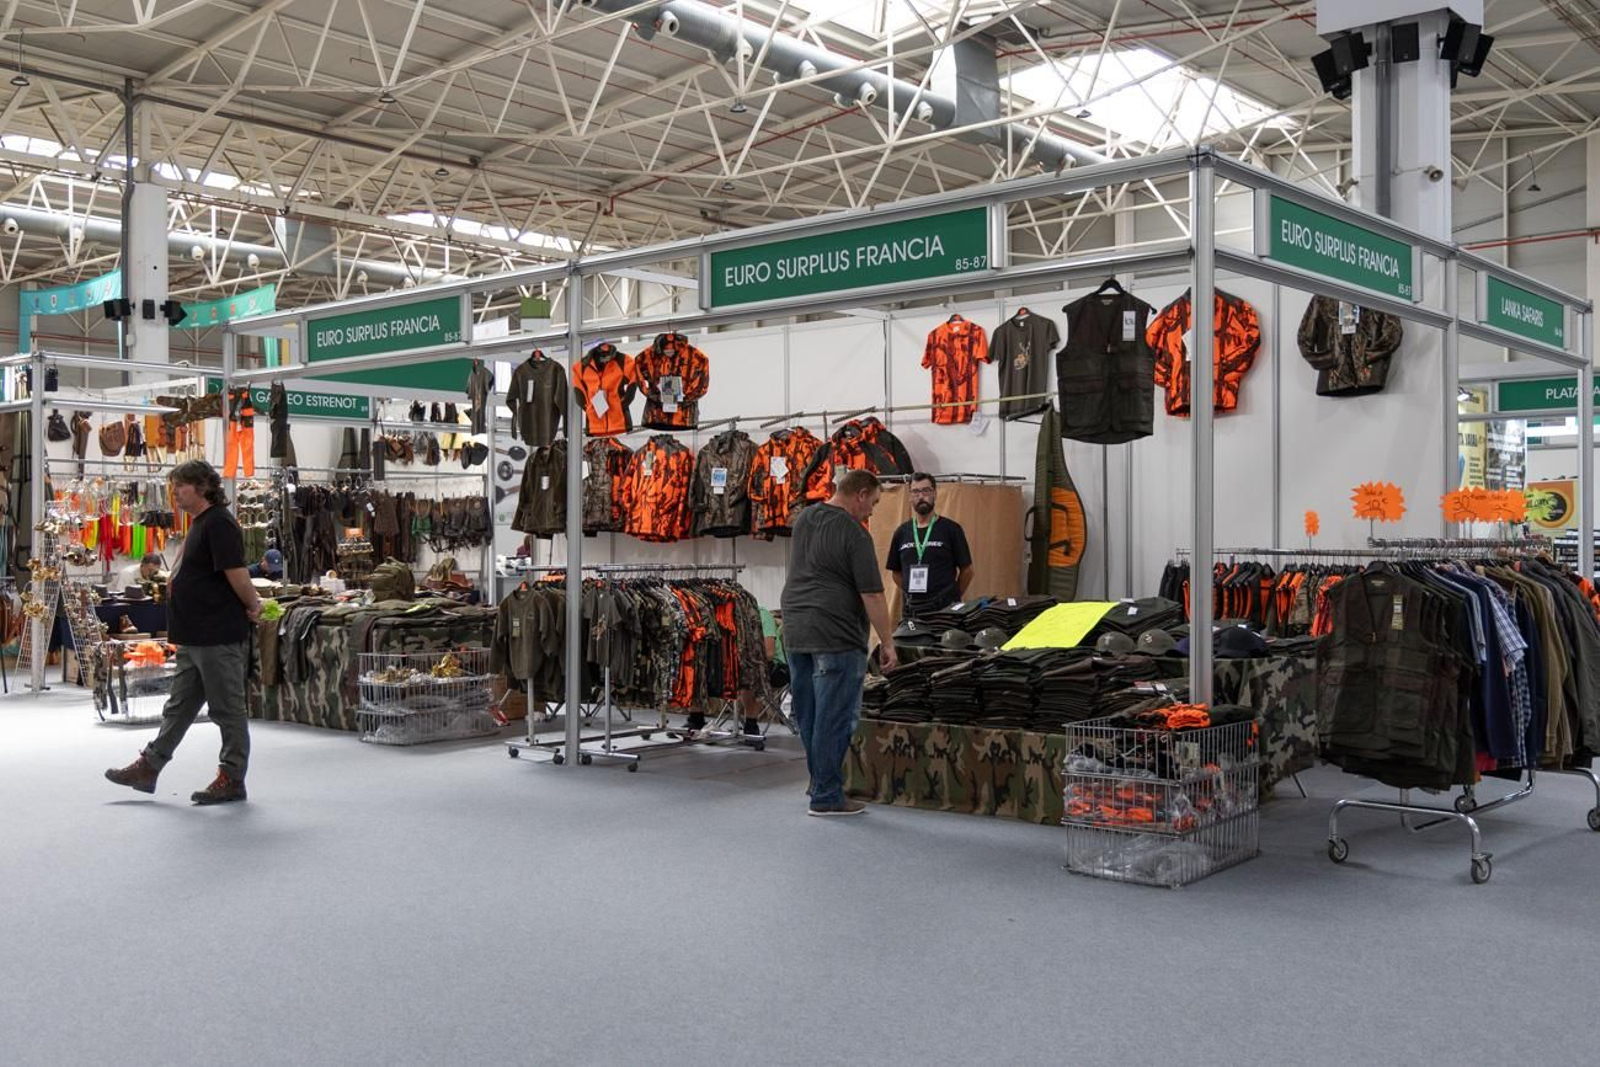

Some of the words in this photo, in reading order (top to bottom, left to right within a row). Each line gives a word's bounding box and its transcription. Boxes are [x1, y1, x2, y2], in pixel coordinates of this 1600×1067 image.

[724, 261, 772, 288] EURO
[776, 249, 850, 280] SURPLUS
[856, 235, 945, 268] FRANCIA
[955, 256, 987, 271] 85-87
[1281, 219, 1312, 249] EURO
[1314, 230, 1356, 265] SURPLUS
[1358, 246, 1400, 279] FRANCIA
[316, 329, 343, 347] EURO
[346, 321, 389, 344] SURPLUS
[391, 314, 440, 337] FRANCIA
[306, 396, 357, 409] ESTRENOT
